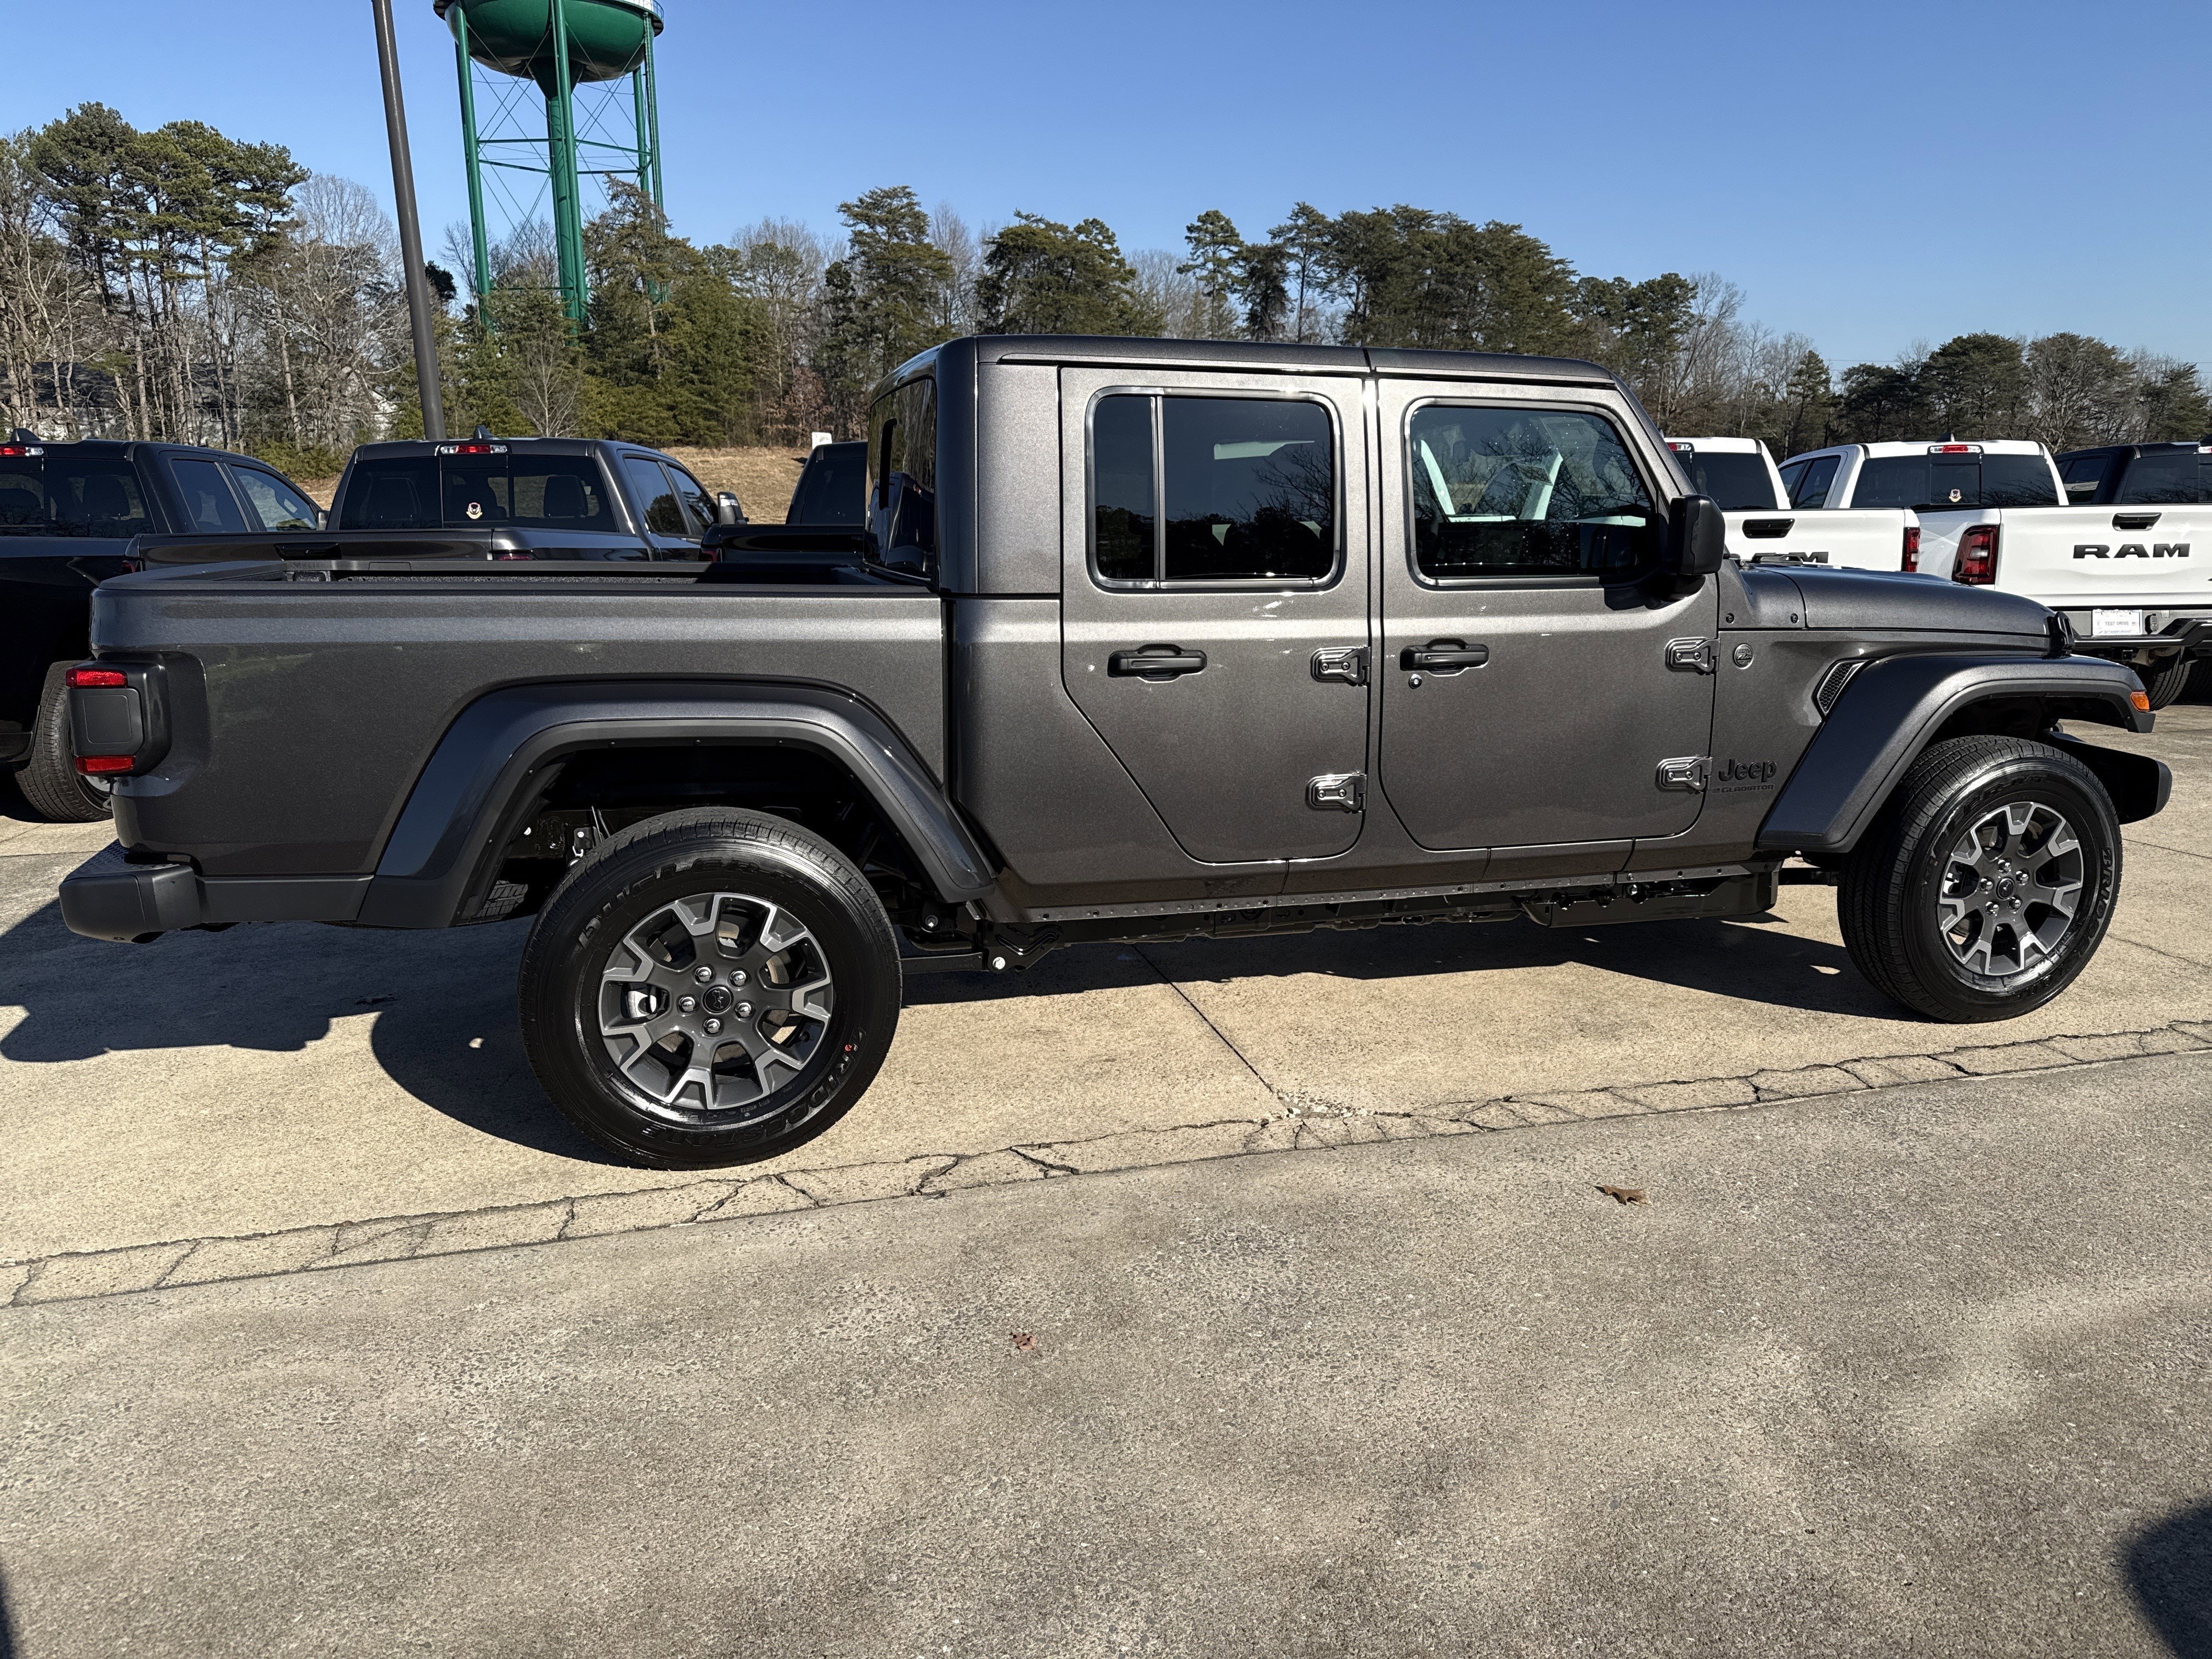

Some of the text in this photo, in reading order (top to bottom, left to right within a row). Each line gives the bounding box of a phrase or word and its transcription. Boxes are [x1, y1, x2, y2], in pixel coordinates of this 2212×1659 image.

[2073, 544, 2191, 558] RAM
[1718, 759, 1777, 783] Jeep
[1721, 784, 1774, 793] GLADIATOR
[640, 1027, 867, 1147] BRIDGESTONE
